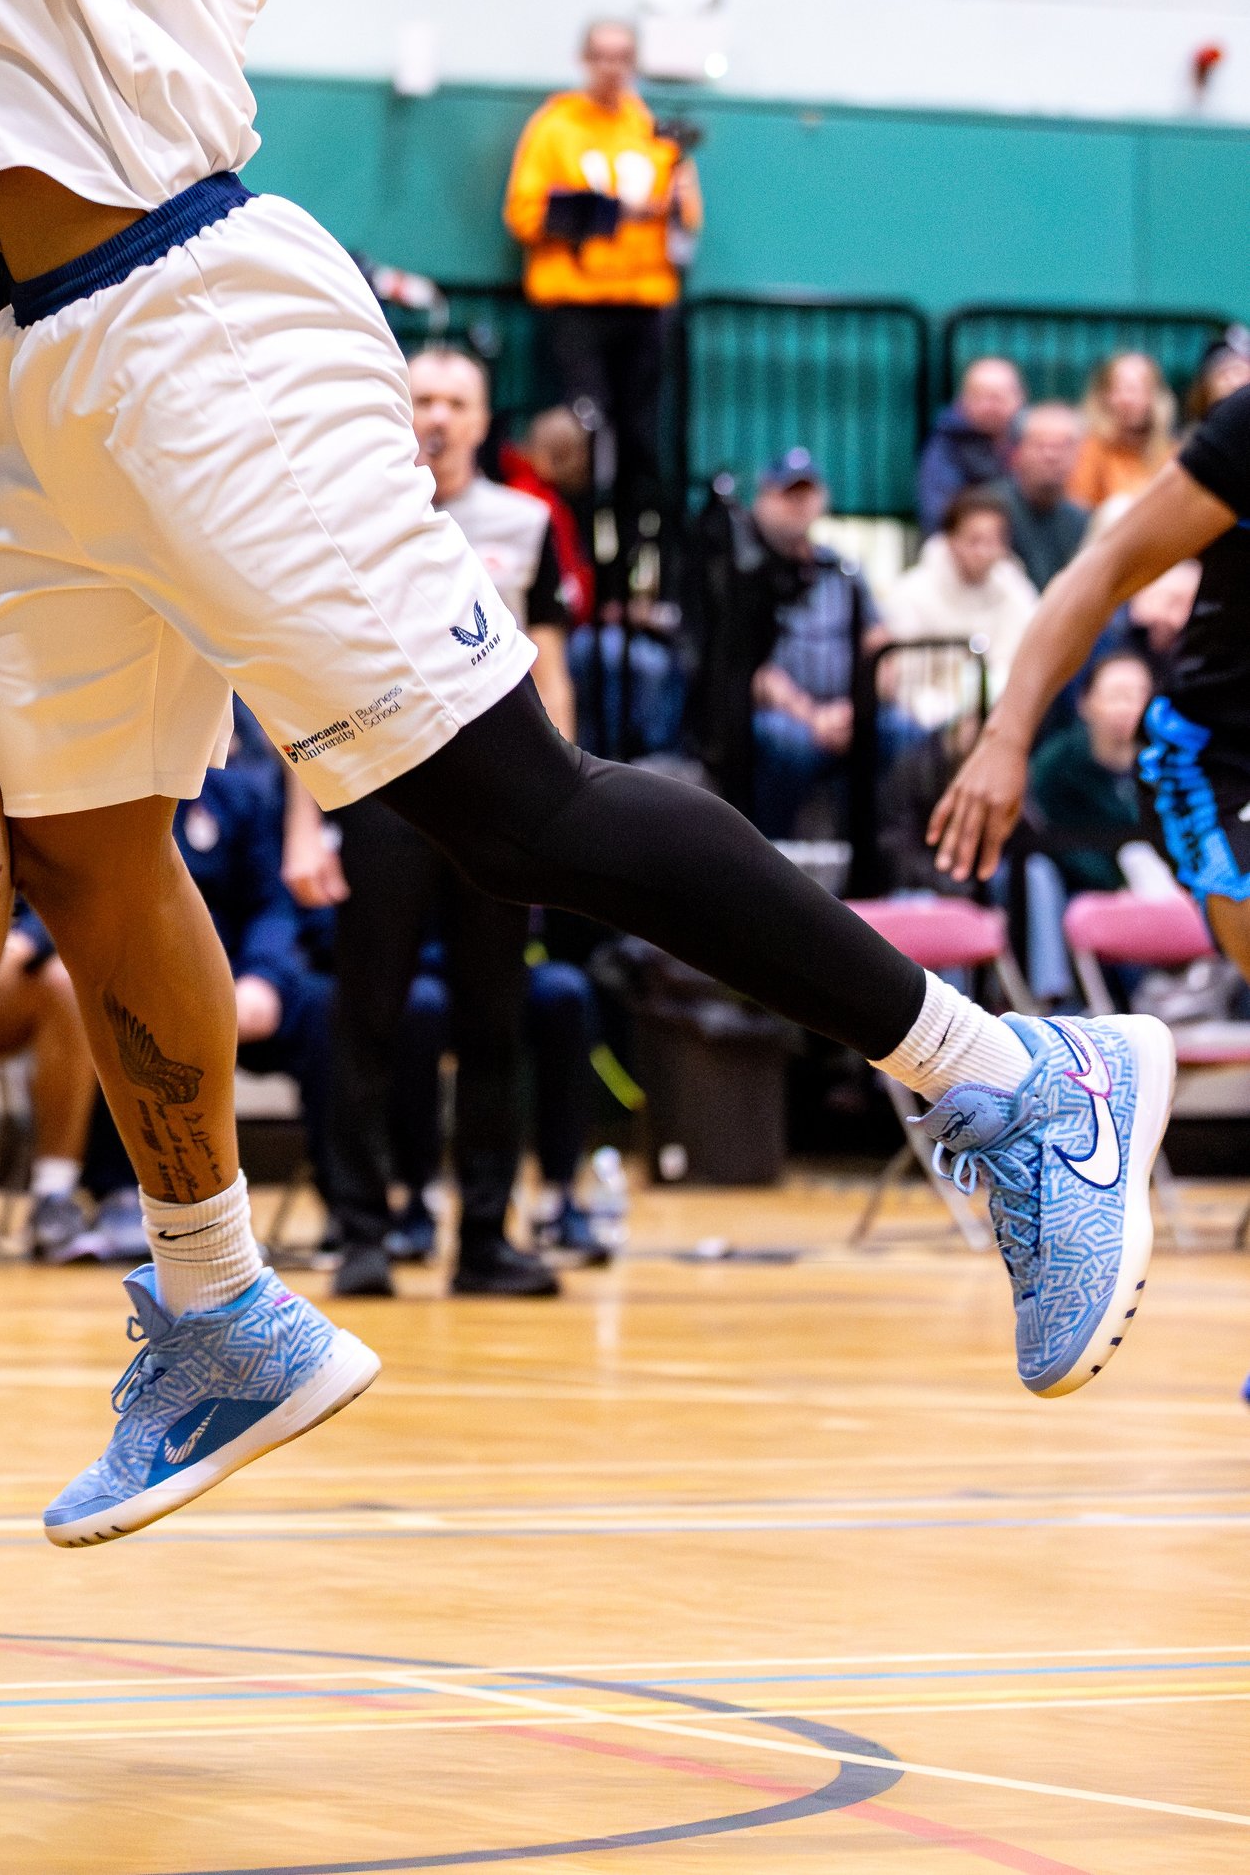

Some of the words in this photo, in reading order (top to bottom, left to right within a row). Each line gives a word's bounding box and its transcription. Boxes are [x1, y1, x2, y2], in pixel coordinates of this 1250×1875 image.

[355, 685, 403, 721] Business
[363, 700, 402, 730] School
[291, 720, 350, 751] Newcastle
[294, 729, 356, 762] University
